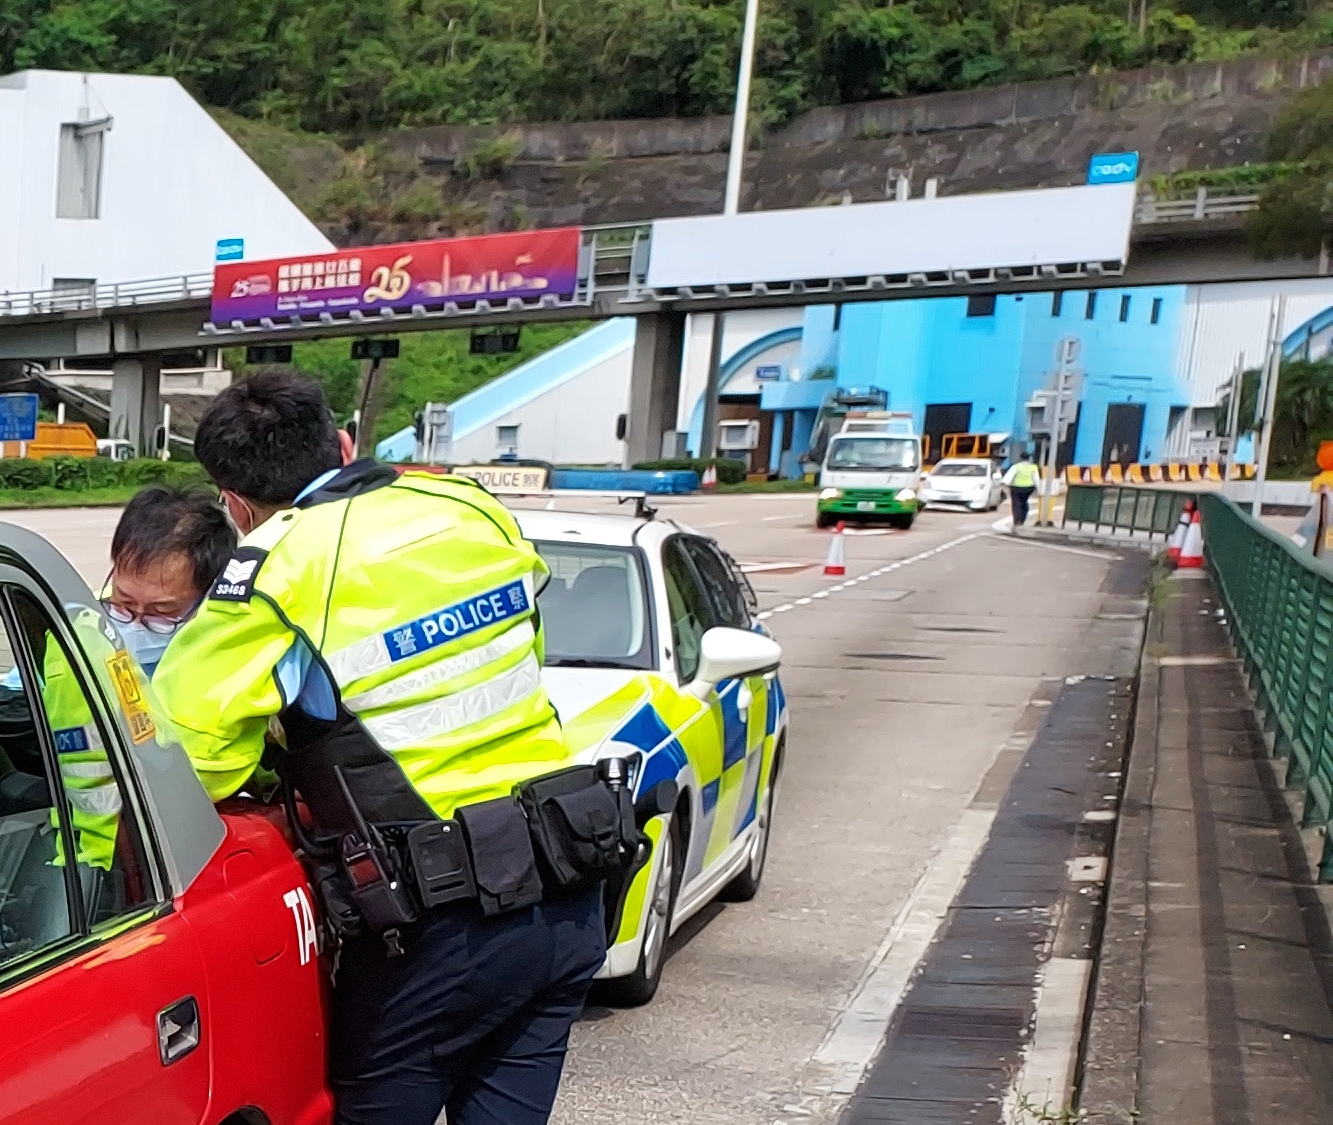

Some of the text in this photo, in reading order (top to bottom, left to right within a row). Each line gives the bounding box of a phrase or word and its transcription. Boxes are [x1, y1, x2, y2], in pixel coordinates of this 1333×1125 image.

[392, 586, 525, 656] 警 POLICE 察
[282, 885, 321, 966] TA
